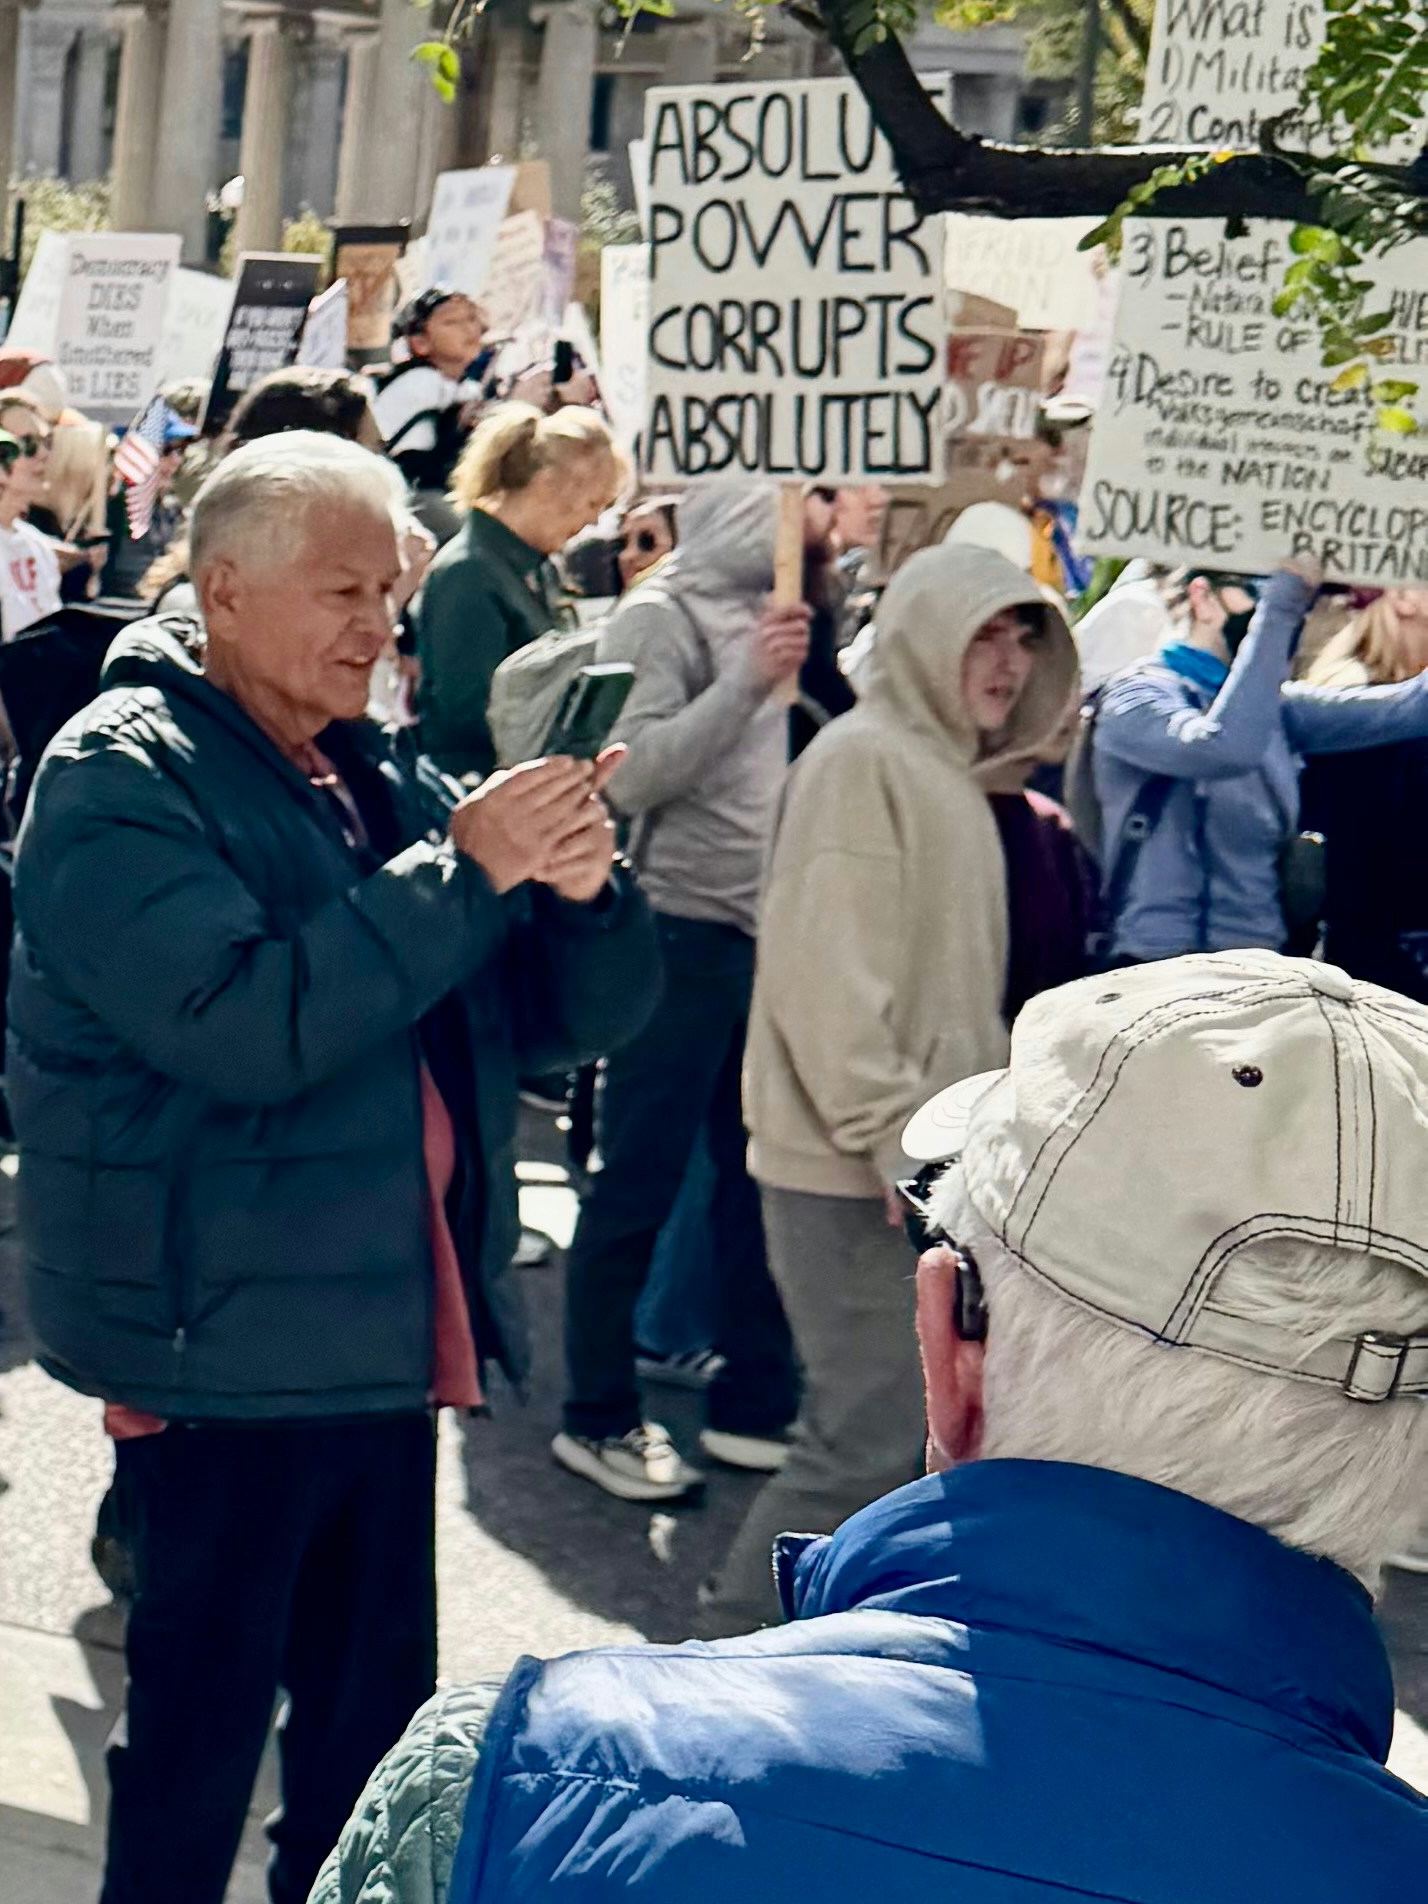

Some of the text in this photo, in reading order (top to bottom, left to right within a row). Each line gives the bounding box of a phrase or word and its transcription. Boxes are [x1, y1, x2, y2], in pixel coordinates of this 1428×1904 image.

[1285, 0, 1318, 51] is
[648, 90, 944, 186] ABSOLU
[648, 192, 931, 281] POWER
[1163, 225, 1284, 284] Belief
[70, 253, 171, 284] Democracy
[87, 283, 143, 312] DIES
[86, 314, 135, 339] When
[648, 295, 938, 379] CORRUPTS
[87, 370, 142, 400] LIES
[1134, 351, 1235, 404] Desire
[1249, 369, 1283, 402] to
[646, 386, 943, 476] ABSOLUTELY
[1221, 460, 1332, 492] NATION
[1086, 479, 1244, 553] SOURCE:
